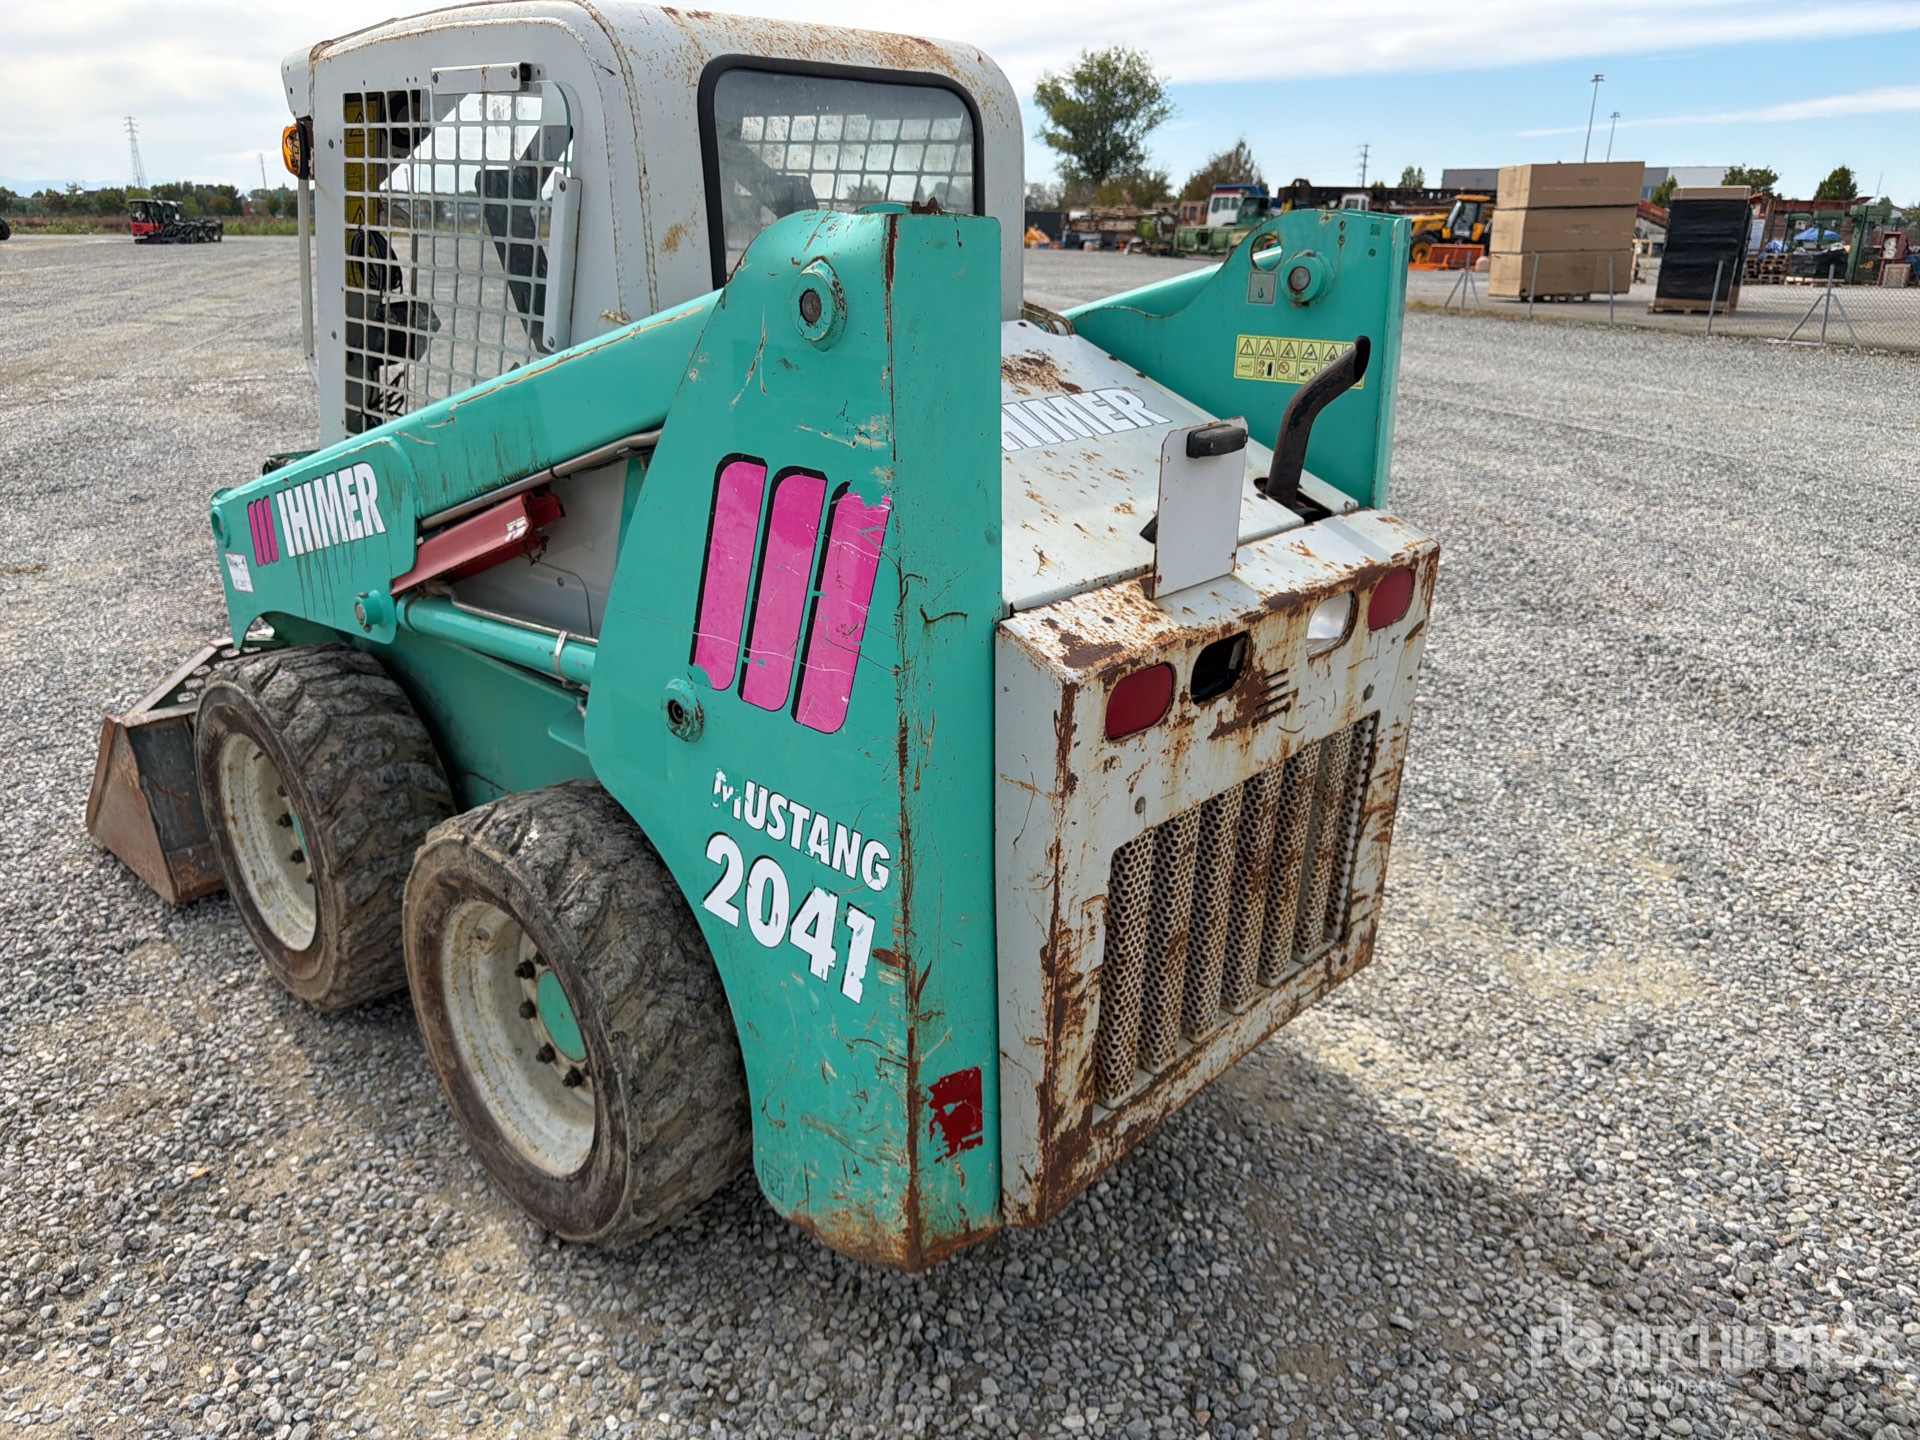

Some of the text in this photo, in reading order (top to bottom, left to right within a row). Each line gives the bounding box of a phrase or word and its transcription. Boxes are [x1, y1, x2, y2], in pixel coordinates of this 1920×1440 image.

[1001, 387, 1173, 452] HIMER
[276, 461, 387, 558] IHIMER
[701, 831, 877, 1006] 2041
